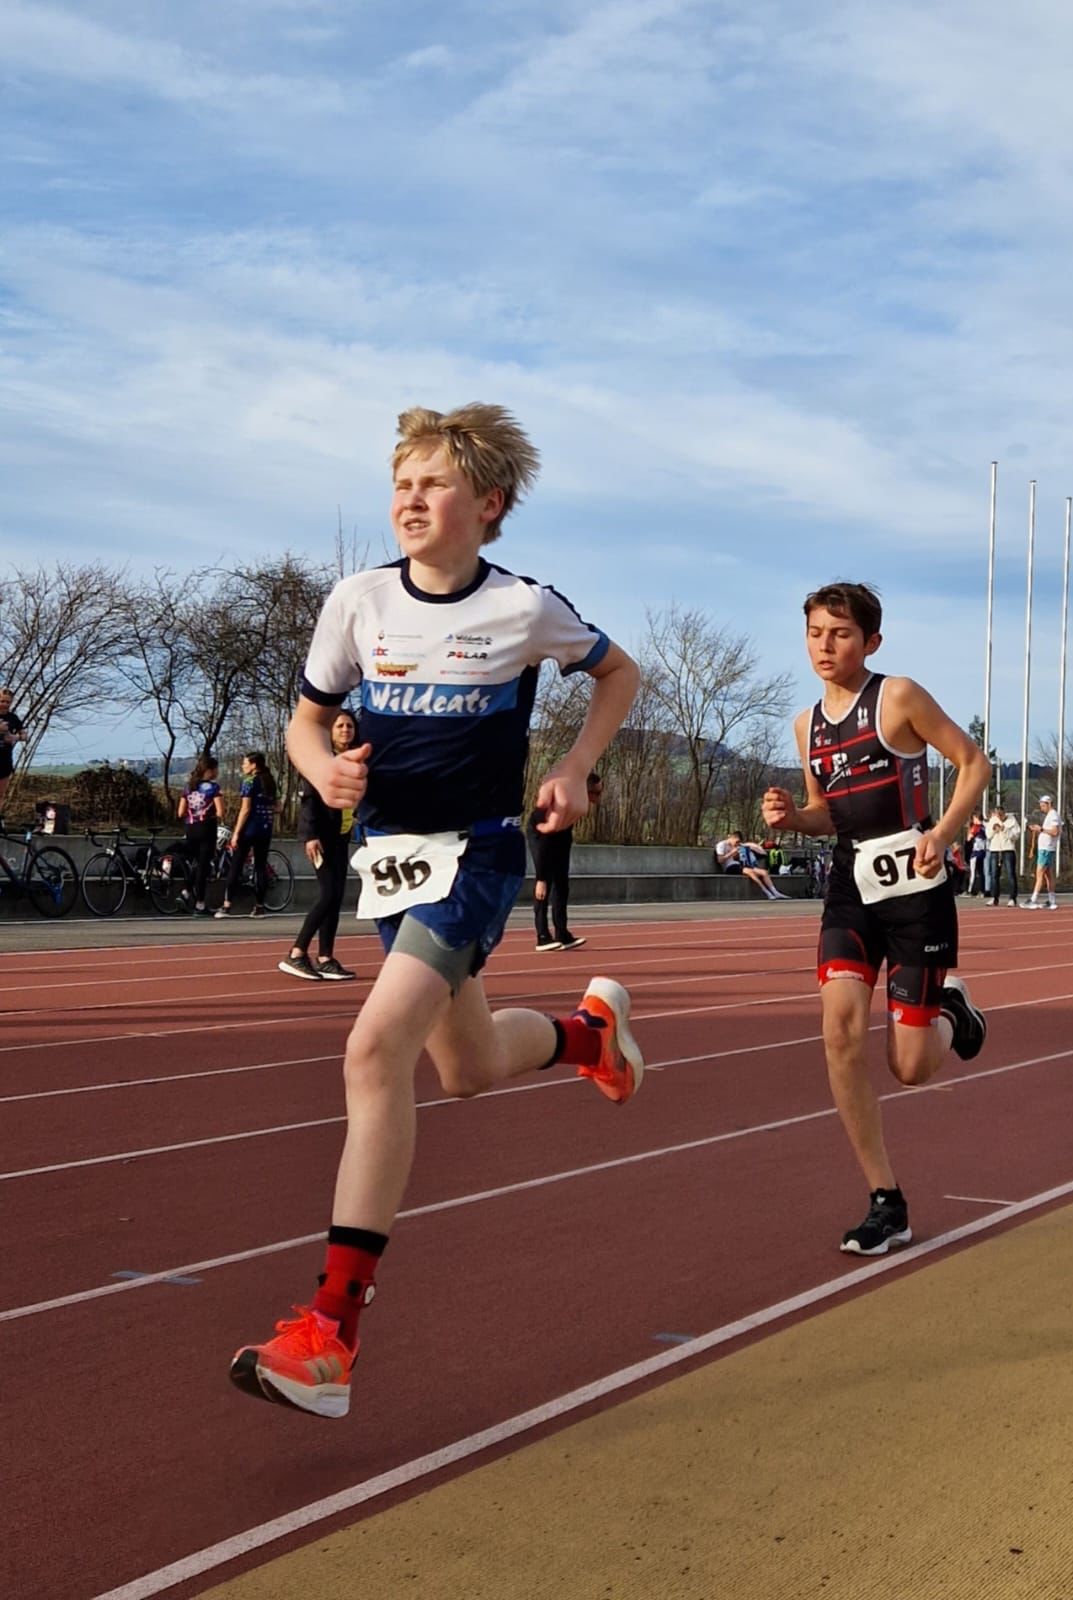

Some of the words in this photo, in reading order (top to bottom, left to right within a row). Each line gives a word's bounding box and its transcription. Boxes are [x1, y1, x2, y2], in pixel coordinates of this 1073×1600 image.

[447, 651, 488, 660] POLAR
[368, 683, 490, 716] Wildcats
[872, 846, 916, 887] 97
